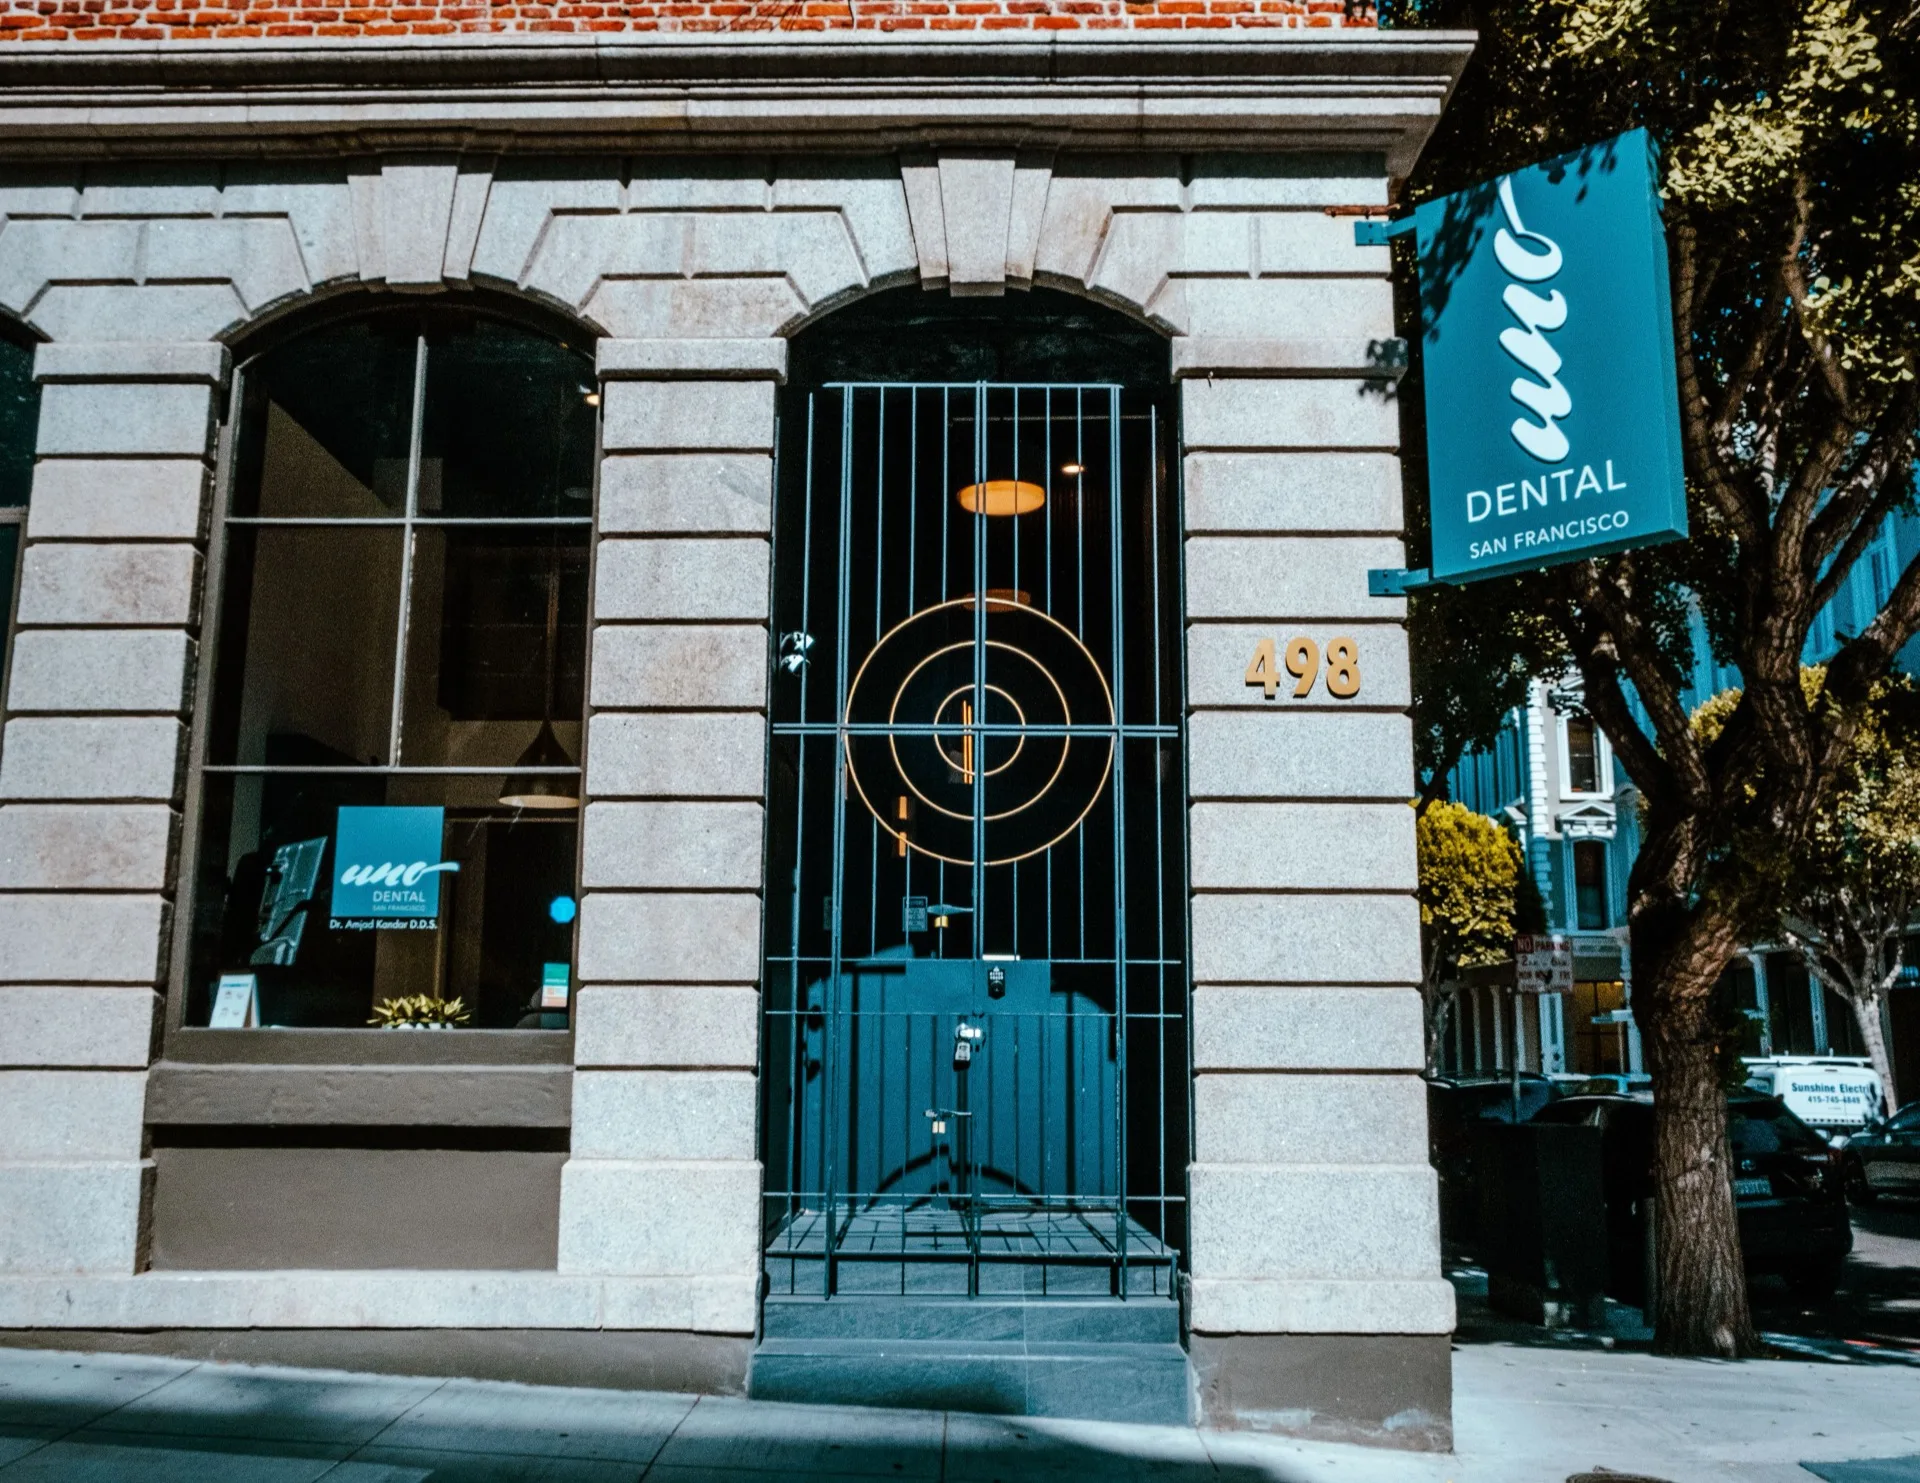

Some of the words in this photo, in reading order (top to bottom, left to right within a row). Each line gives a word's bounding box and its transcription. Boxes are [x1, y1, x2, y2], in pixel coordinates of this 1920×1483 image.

[1494, 175, 1572, 463] uno
[1466, 459, 1627, 523] DENTAL
[1469, 537, 1507, 559] SAN
[1514, 510, 1629, 549] FRANCISCO
[1245, 636, 1361, 700] 498
[340, 861, 459, 887] uno
[372, 891, 426, 903] DENTAL
[372, 904, 386, 912] SAN
[388, 904, 426, 912] FRANCISCO
[329, 919, 343, 929] Dr.
[345, 919, 374, 931] Amjad
[409, 919, 438, 929] D.D.S.
[1791, 1082, 1836, 1093] Sunshine
[1839, 1083, 1874, 1093] Electri
